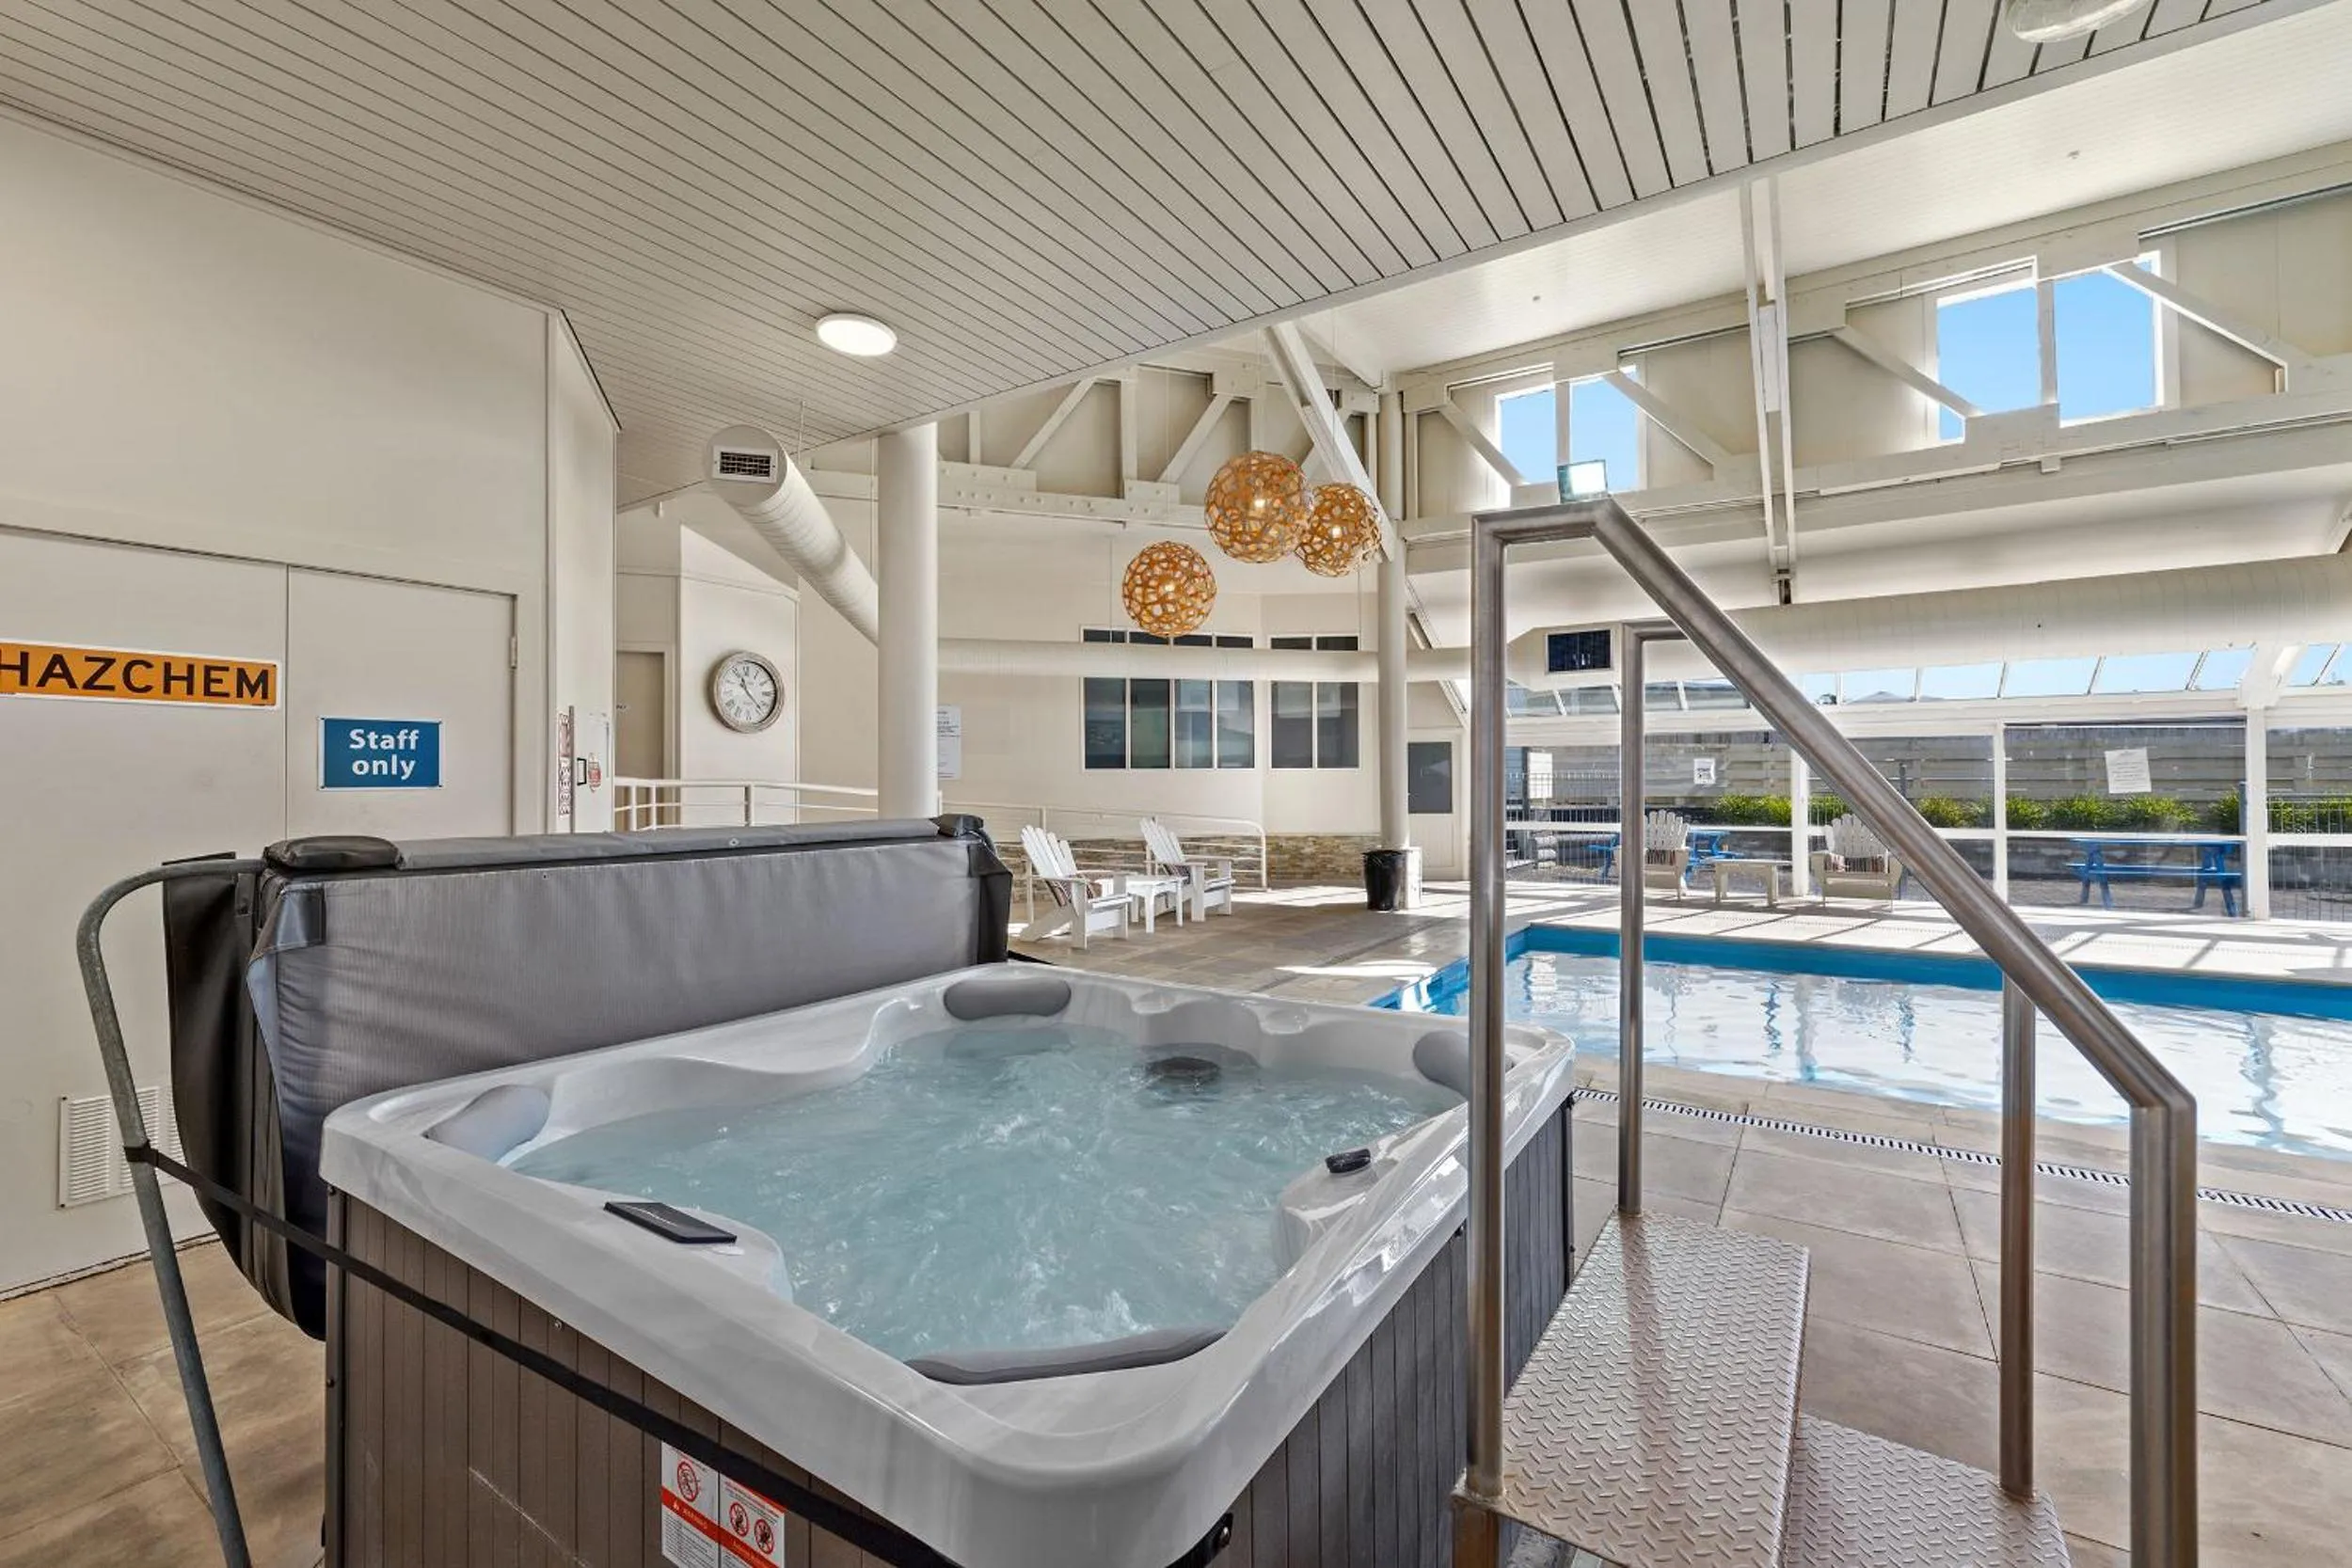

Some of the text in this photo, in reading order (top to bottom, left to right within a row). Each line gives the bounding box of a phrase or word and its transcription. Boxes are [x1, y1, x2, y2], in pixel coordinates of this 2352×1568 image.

[0, 650, 269, 700] HAZCHEM
[349, 728, 420, 750] Staff
[352, 753, 416, 781] only
